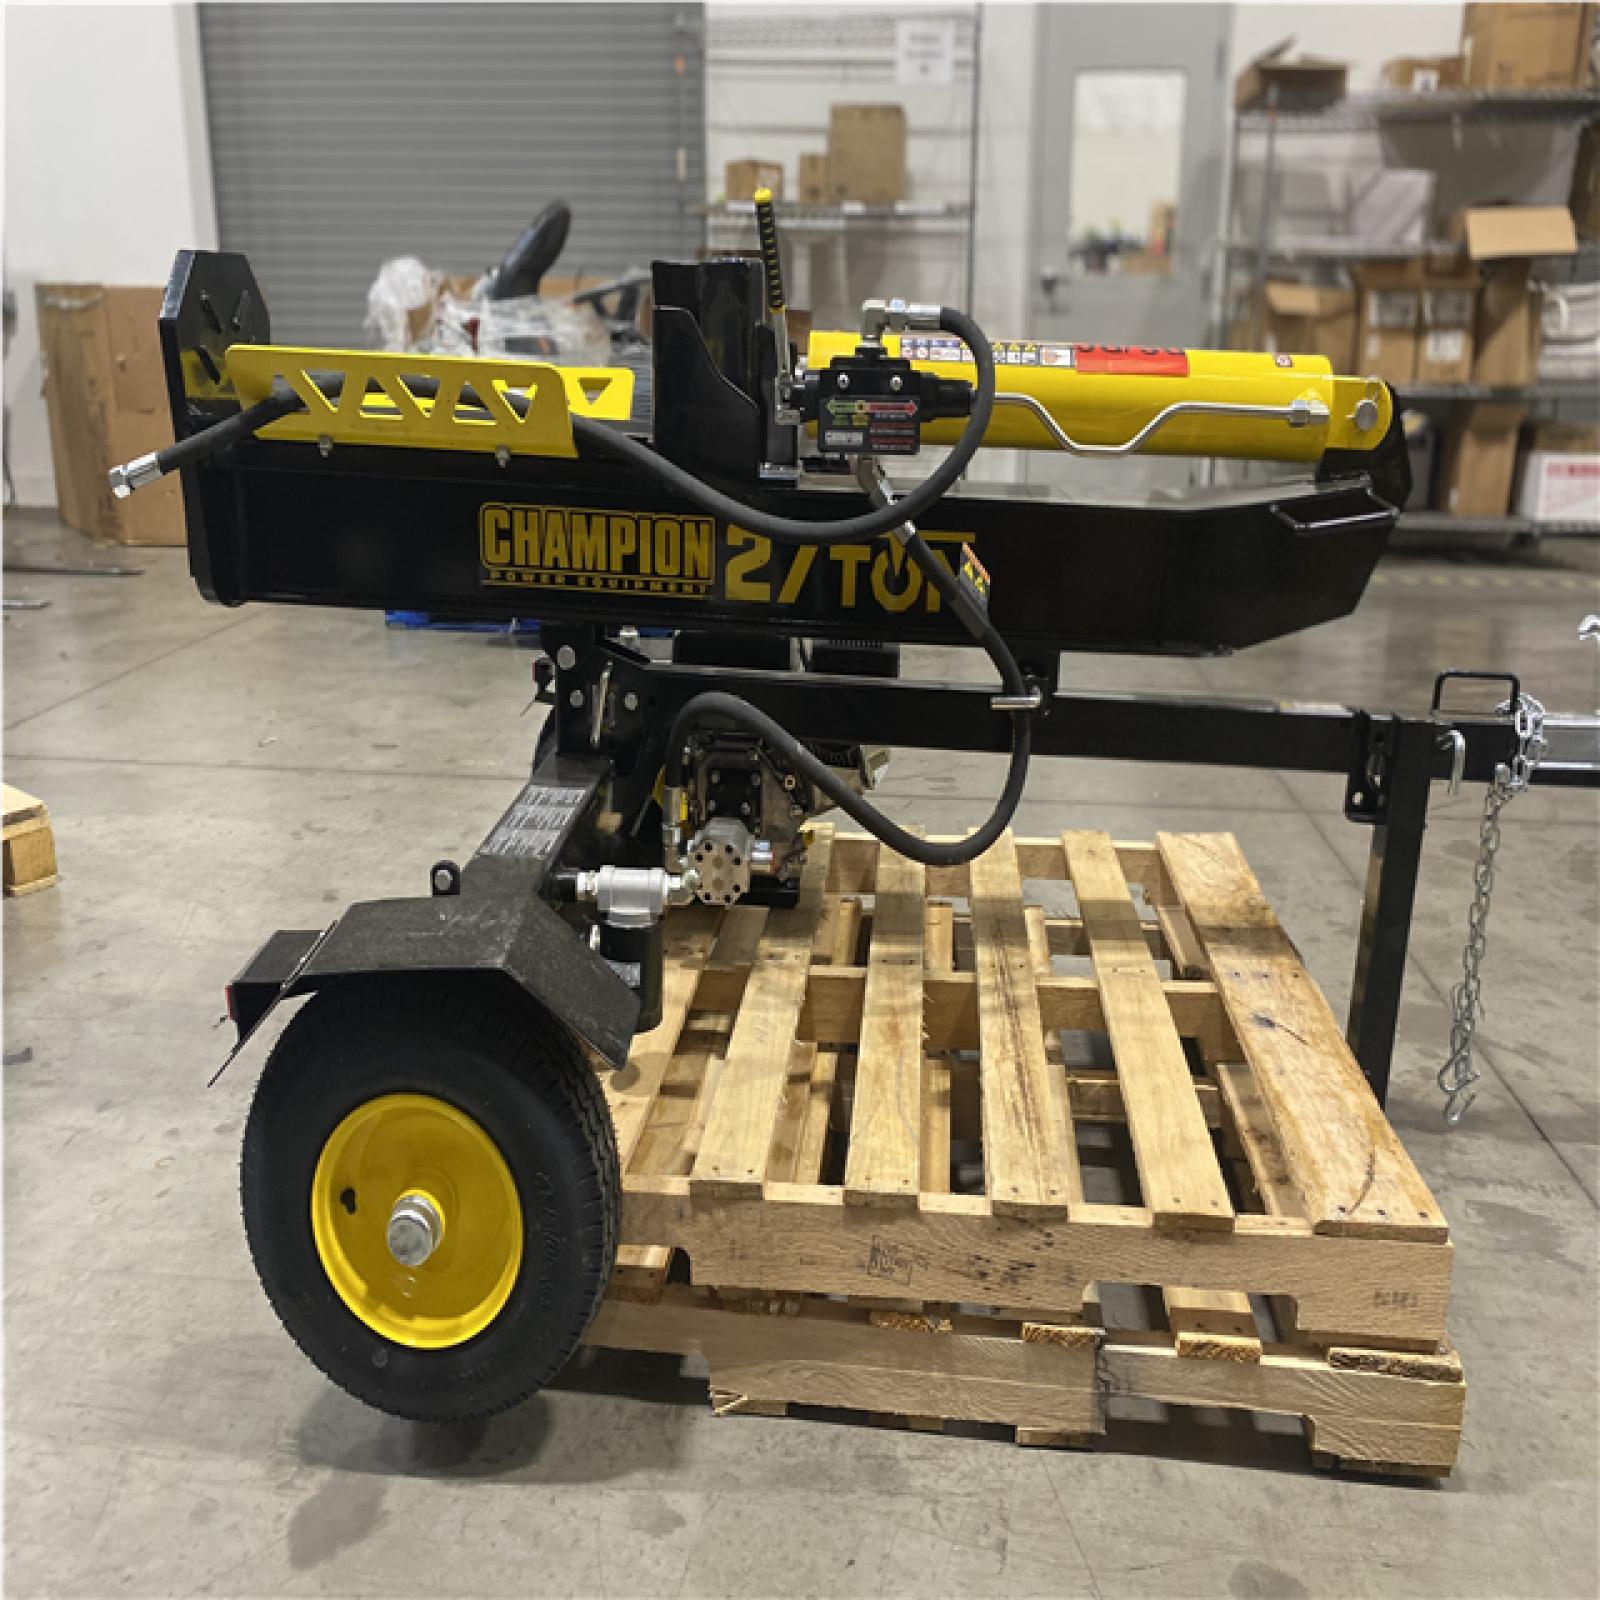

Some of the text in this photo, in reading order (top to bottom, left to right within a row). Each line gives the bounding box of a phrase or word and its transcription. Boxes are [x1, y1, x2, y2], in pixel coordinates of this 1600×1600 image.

[484, 508, 711, 578] CHAMPION
[489, 568, 706, 595] POWER EQUIPMENT
